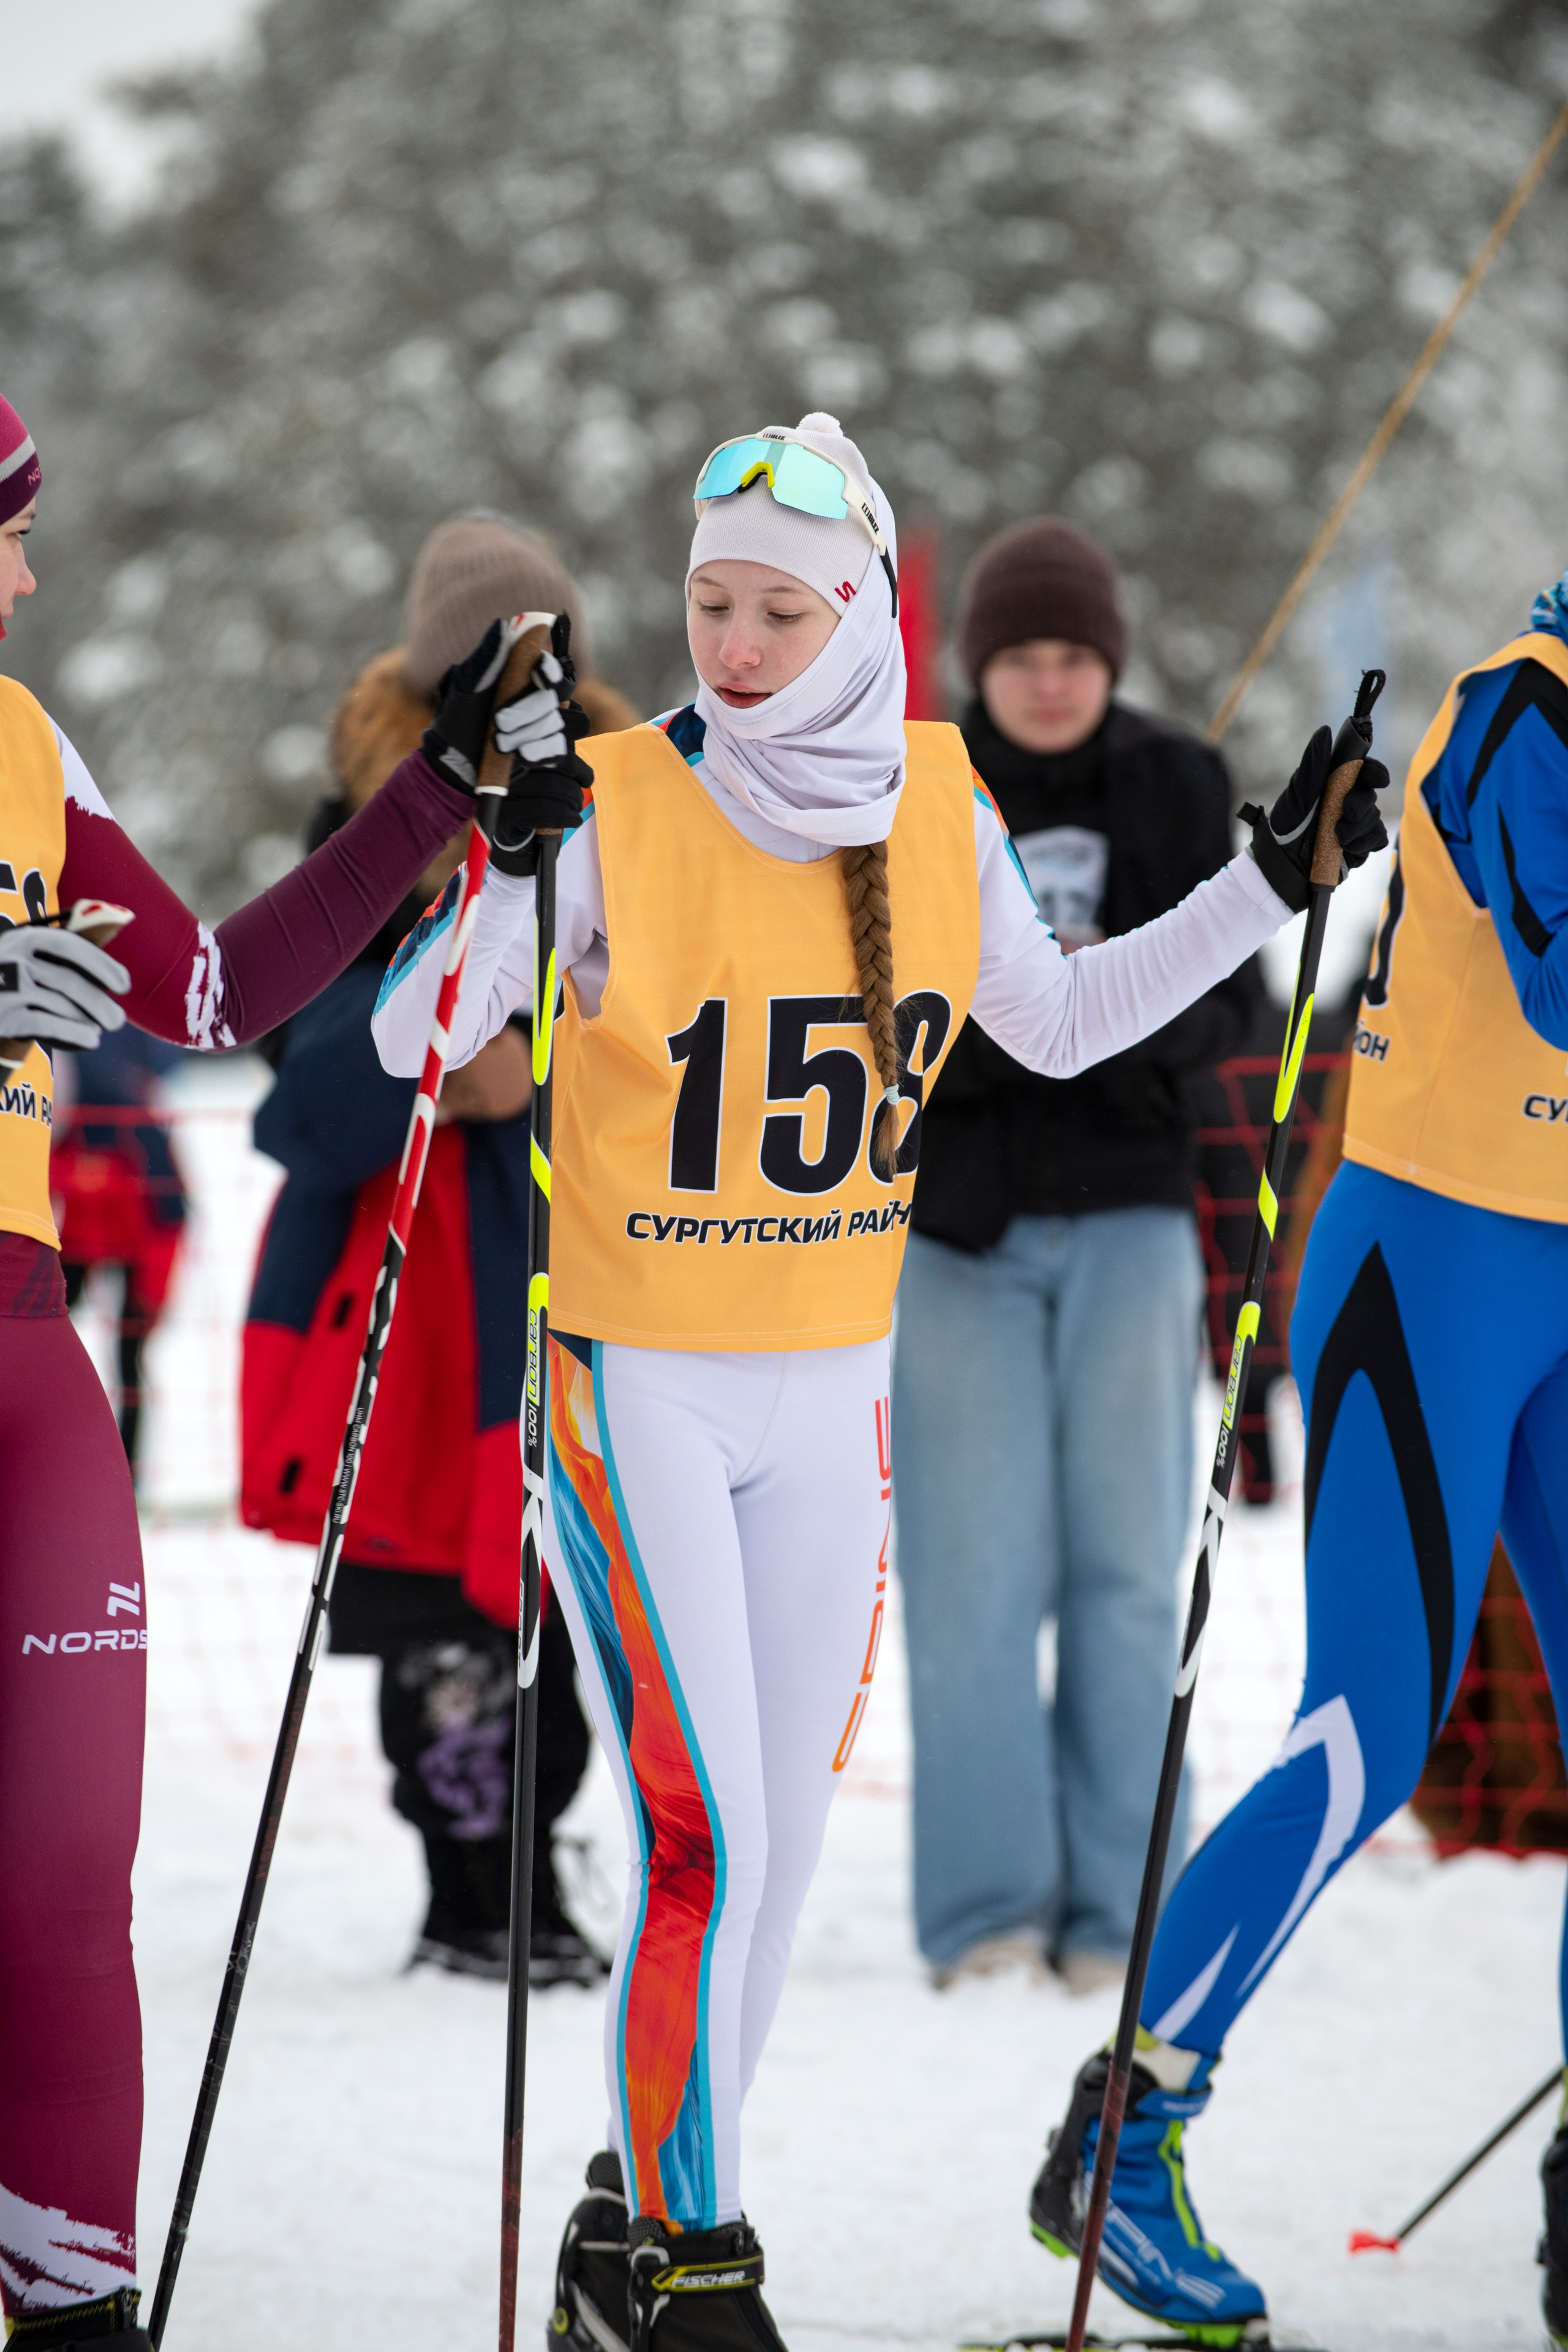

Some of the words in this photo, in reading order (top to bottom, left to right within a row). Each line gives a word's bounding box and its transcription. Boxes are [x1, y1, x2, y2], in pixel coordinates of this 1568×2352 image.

[626, 1208, 842, 1245] СУРГУТСКИЙ
[527, 1402, 538, 1447] 100%
[672, 2270, 746, 2288] FISCHER
